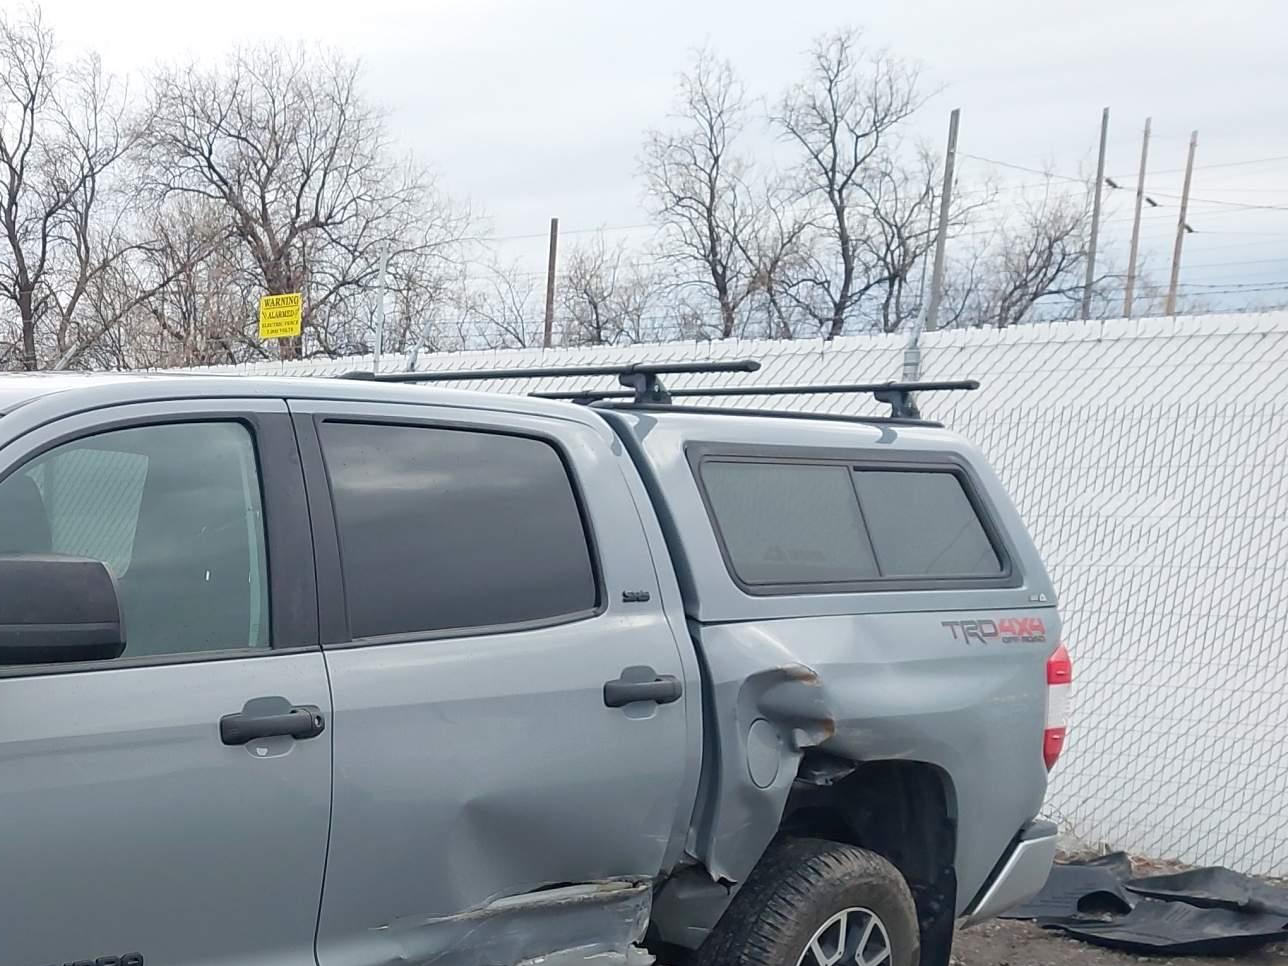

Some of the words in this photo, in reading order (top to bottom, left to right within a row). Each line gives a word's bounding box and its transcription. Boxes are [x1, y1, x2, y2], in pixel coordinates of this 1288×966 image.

[264, 296, 299, 307] WARNING
[268, 310, 295, 319] ALARMED
[941, 618, 999, 646] TRD
